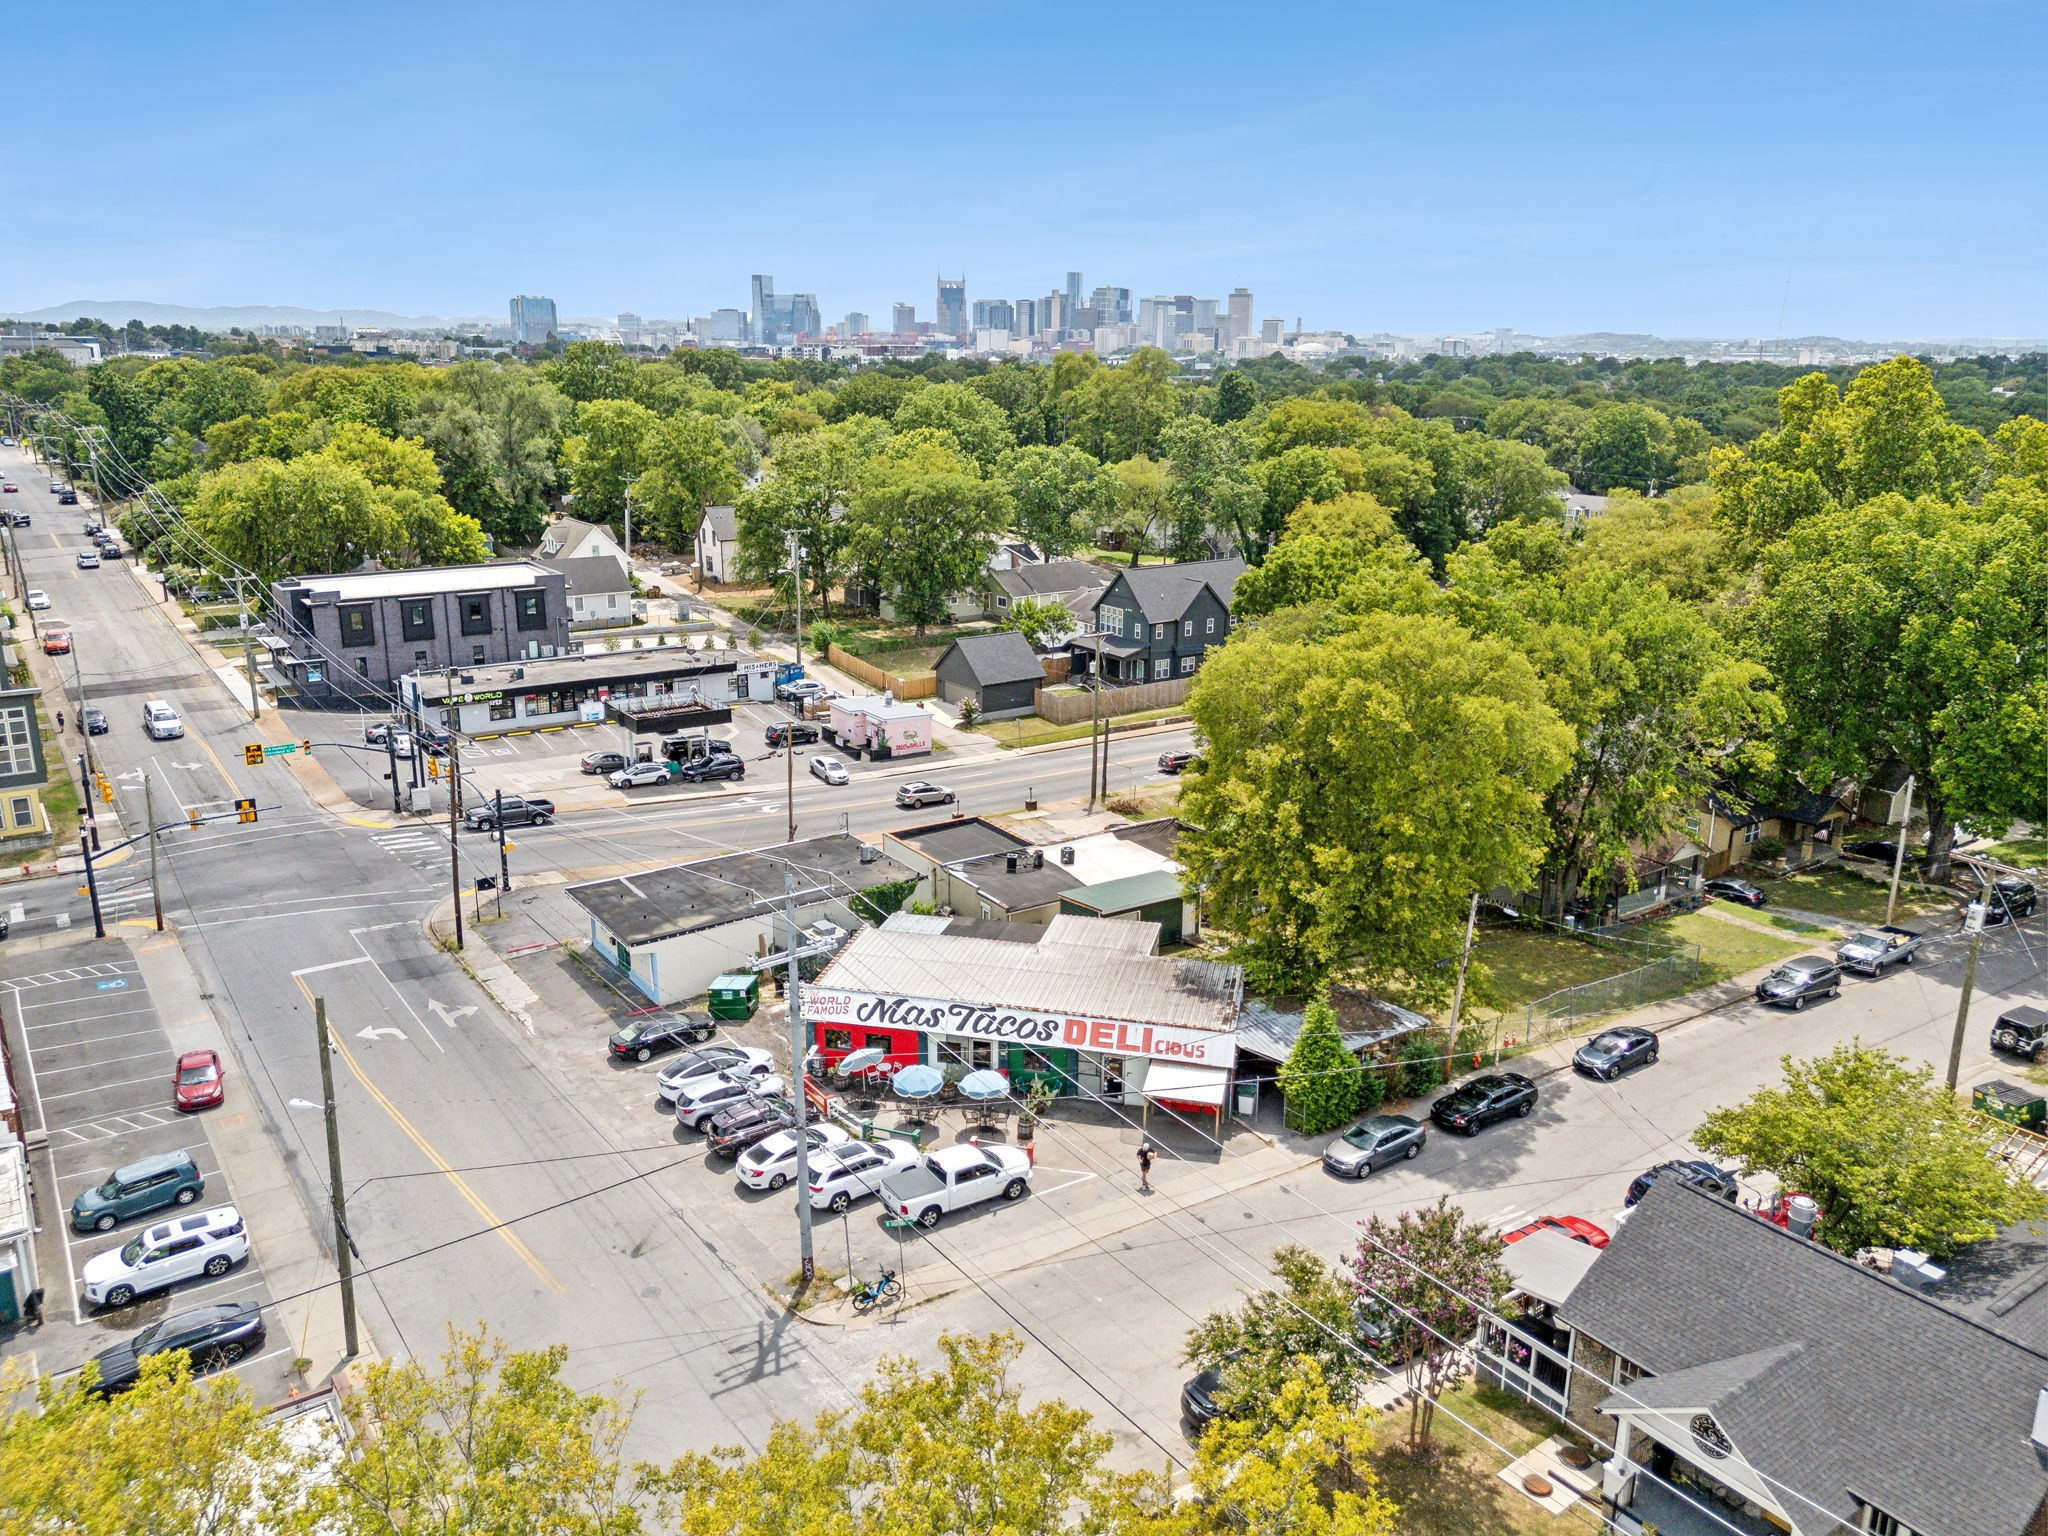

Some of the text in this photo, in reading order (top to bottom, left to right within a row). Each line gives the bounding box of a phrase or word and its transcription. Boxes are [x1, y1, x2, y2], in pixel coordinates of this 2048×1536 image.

[760, 661, 777, 669] HERS
[473, 691, 503, 701] WORLD
[895, 741, 926, 751] SNOWBALLS
[810, 995, 852, 1006] WORLD
[807, 1005, 850, 1015] FAMOUS
[856, 997, 946, 1028] Mas
[948, 1003, 1060, 1042] Tacos
